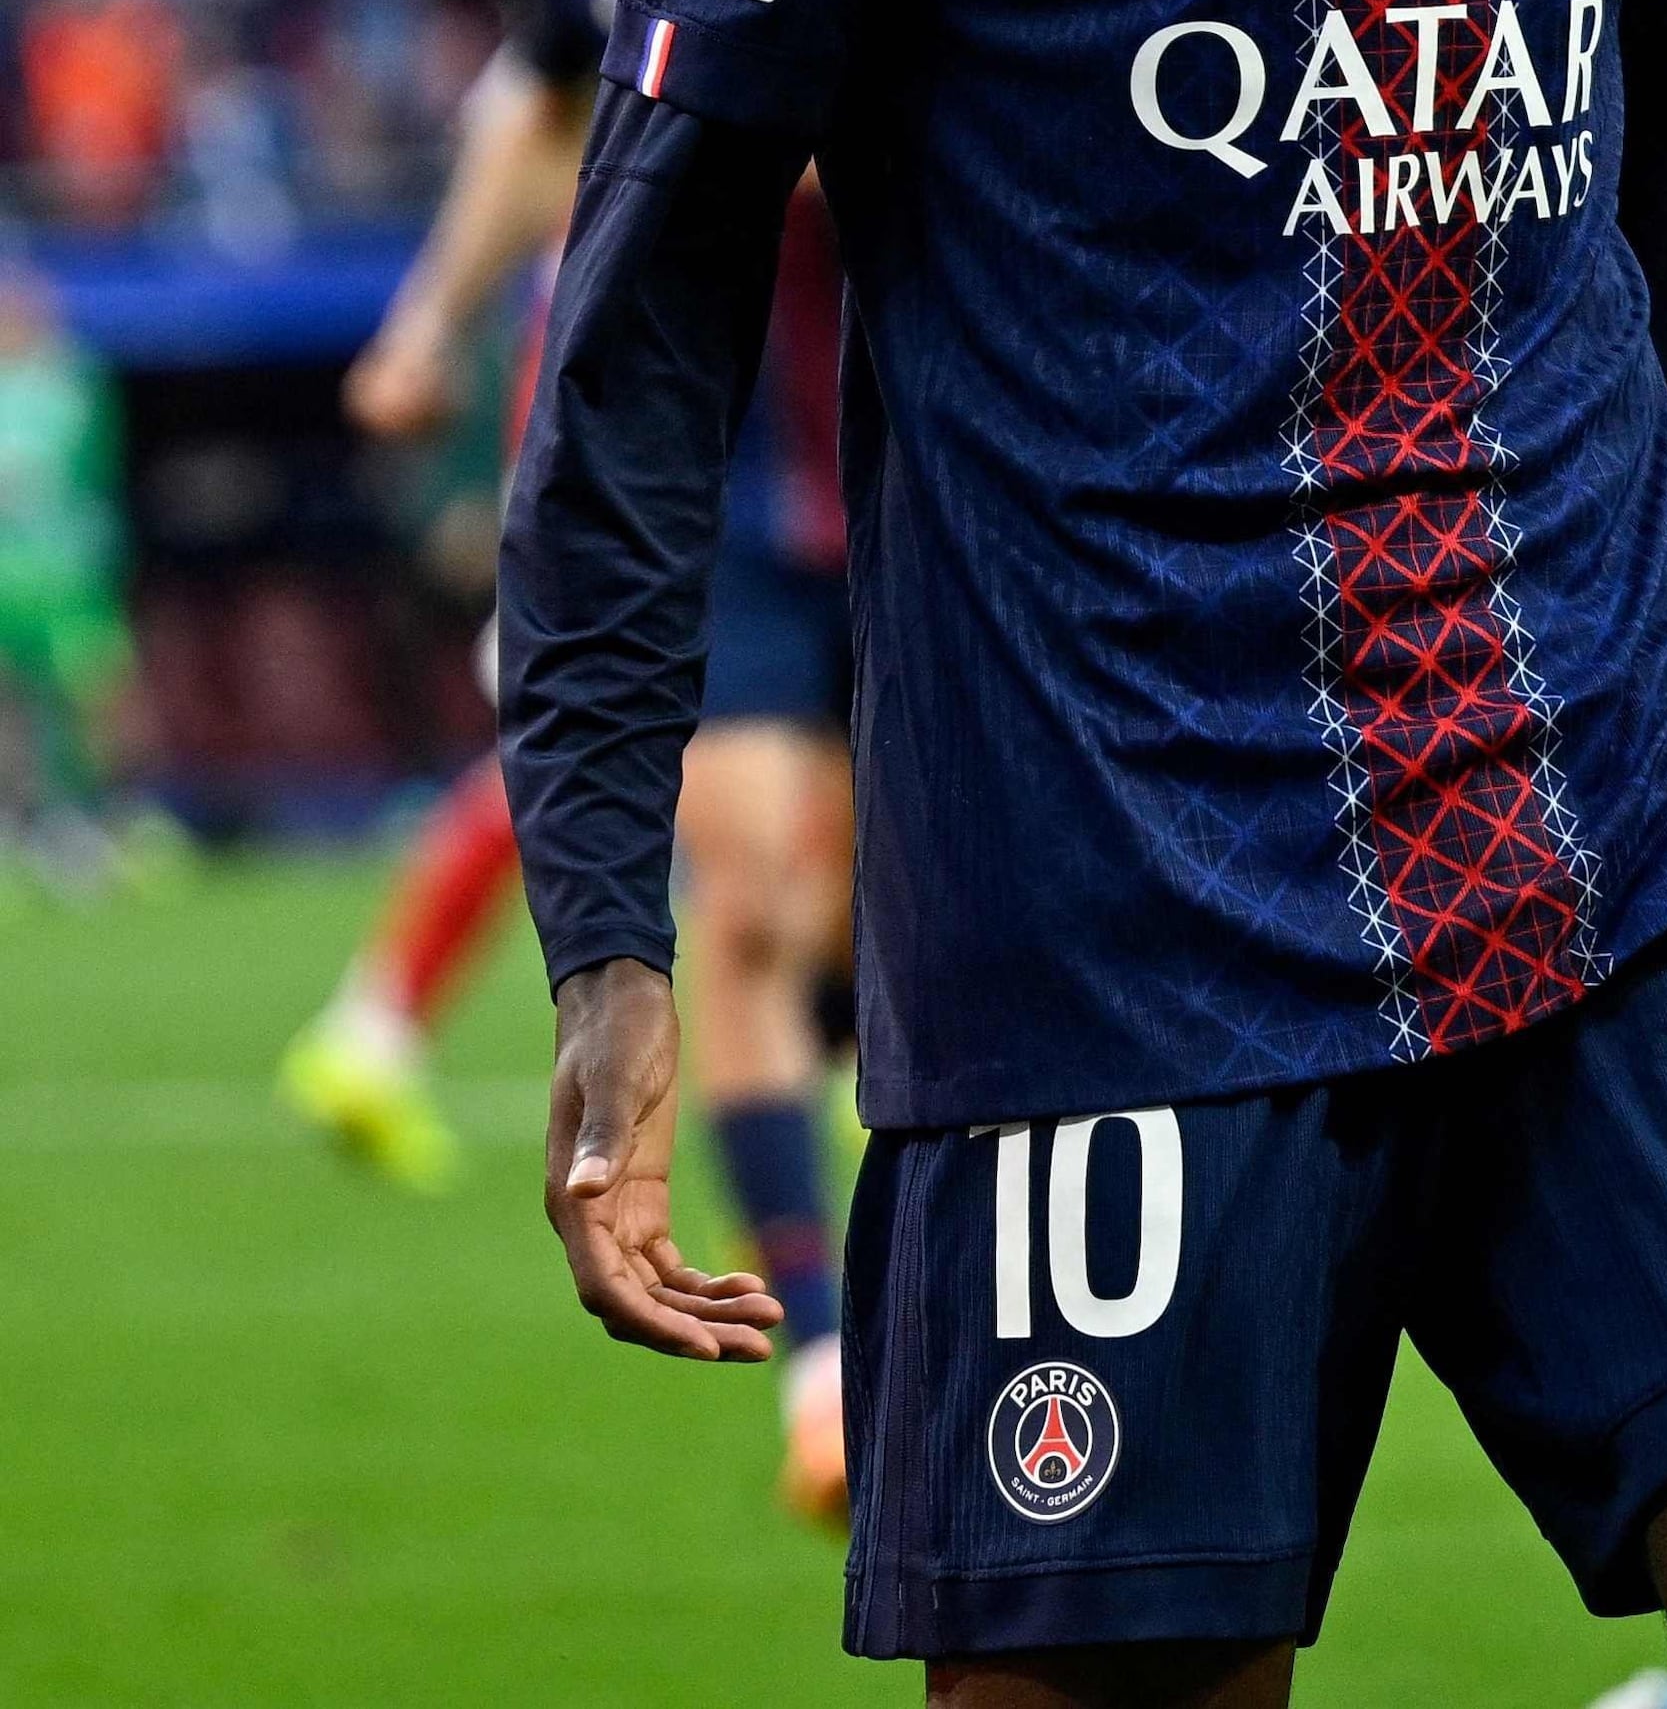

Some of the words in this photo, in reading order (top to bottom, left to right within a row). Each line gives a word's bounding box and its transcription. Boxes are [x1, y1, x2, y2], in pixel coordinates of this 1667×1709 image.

[1282, 130, 1593, 237] AIRWAYS
[969, 1104, 1183, 1338] 10
[1010, 1369, 1097, 1408] PARIS
